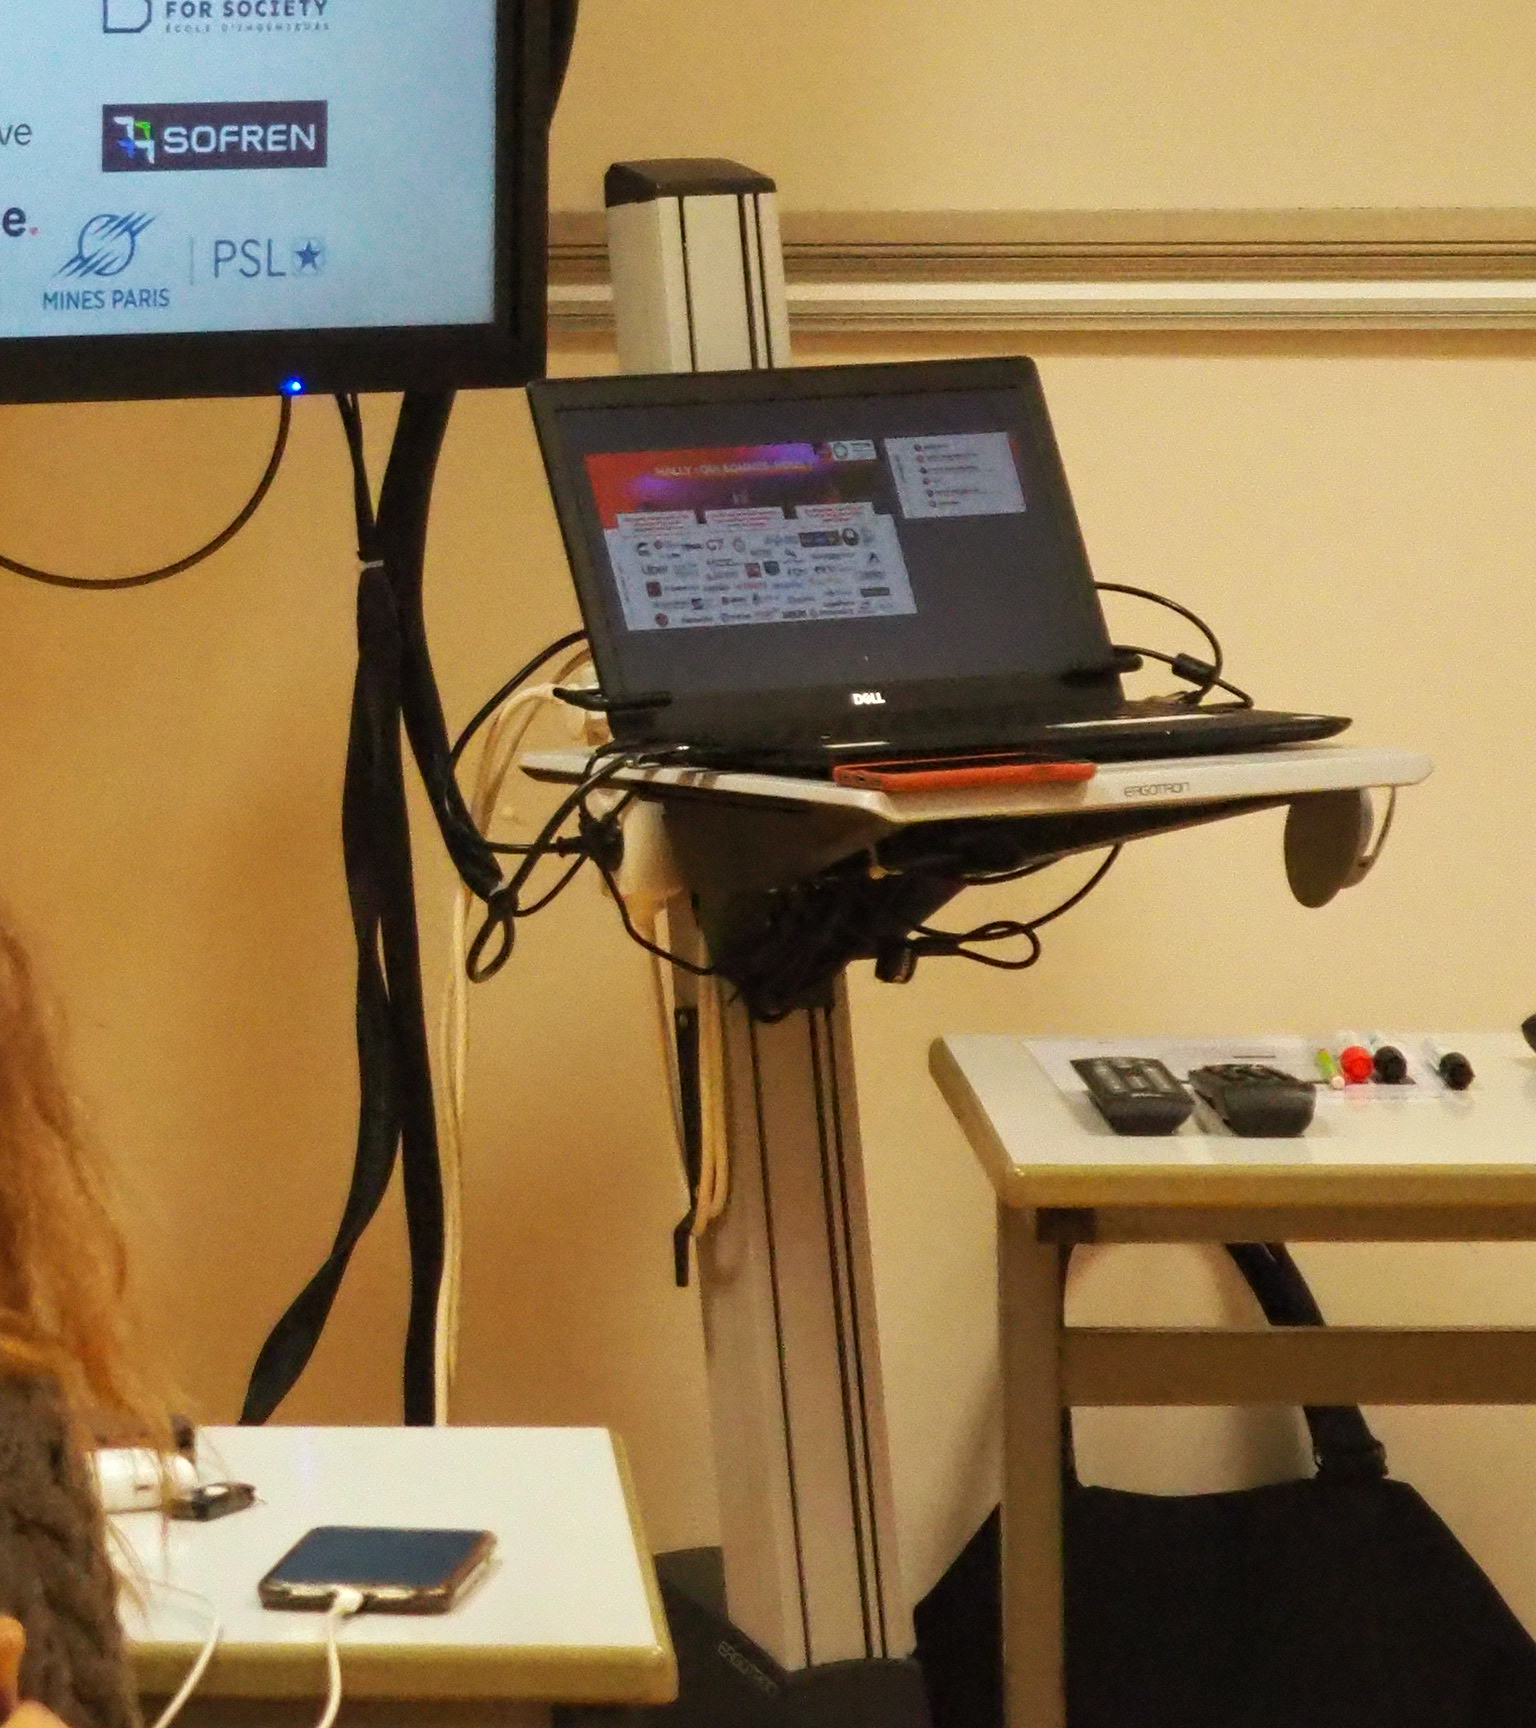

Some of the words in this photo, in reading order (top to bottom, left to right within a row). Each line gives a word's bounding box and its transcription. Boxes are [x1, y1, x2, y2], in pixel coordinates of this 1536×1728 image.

[166, 0, 213, 18] FOR
[222, 0, 328, 18] SOCIETY
[164, 122, 316, 155] SOFREN
[212, 239, 286, 279] PSL
[41, 288, 106, 311] MINES
[111, 286, 170, 310] PARIS
[852, 692, 886, 706] DELL
[1124, 782, 1190, 797] ERGOTRON
